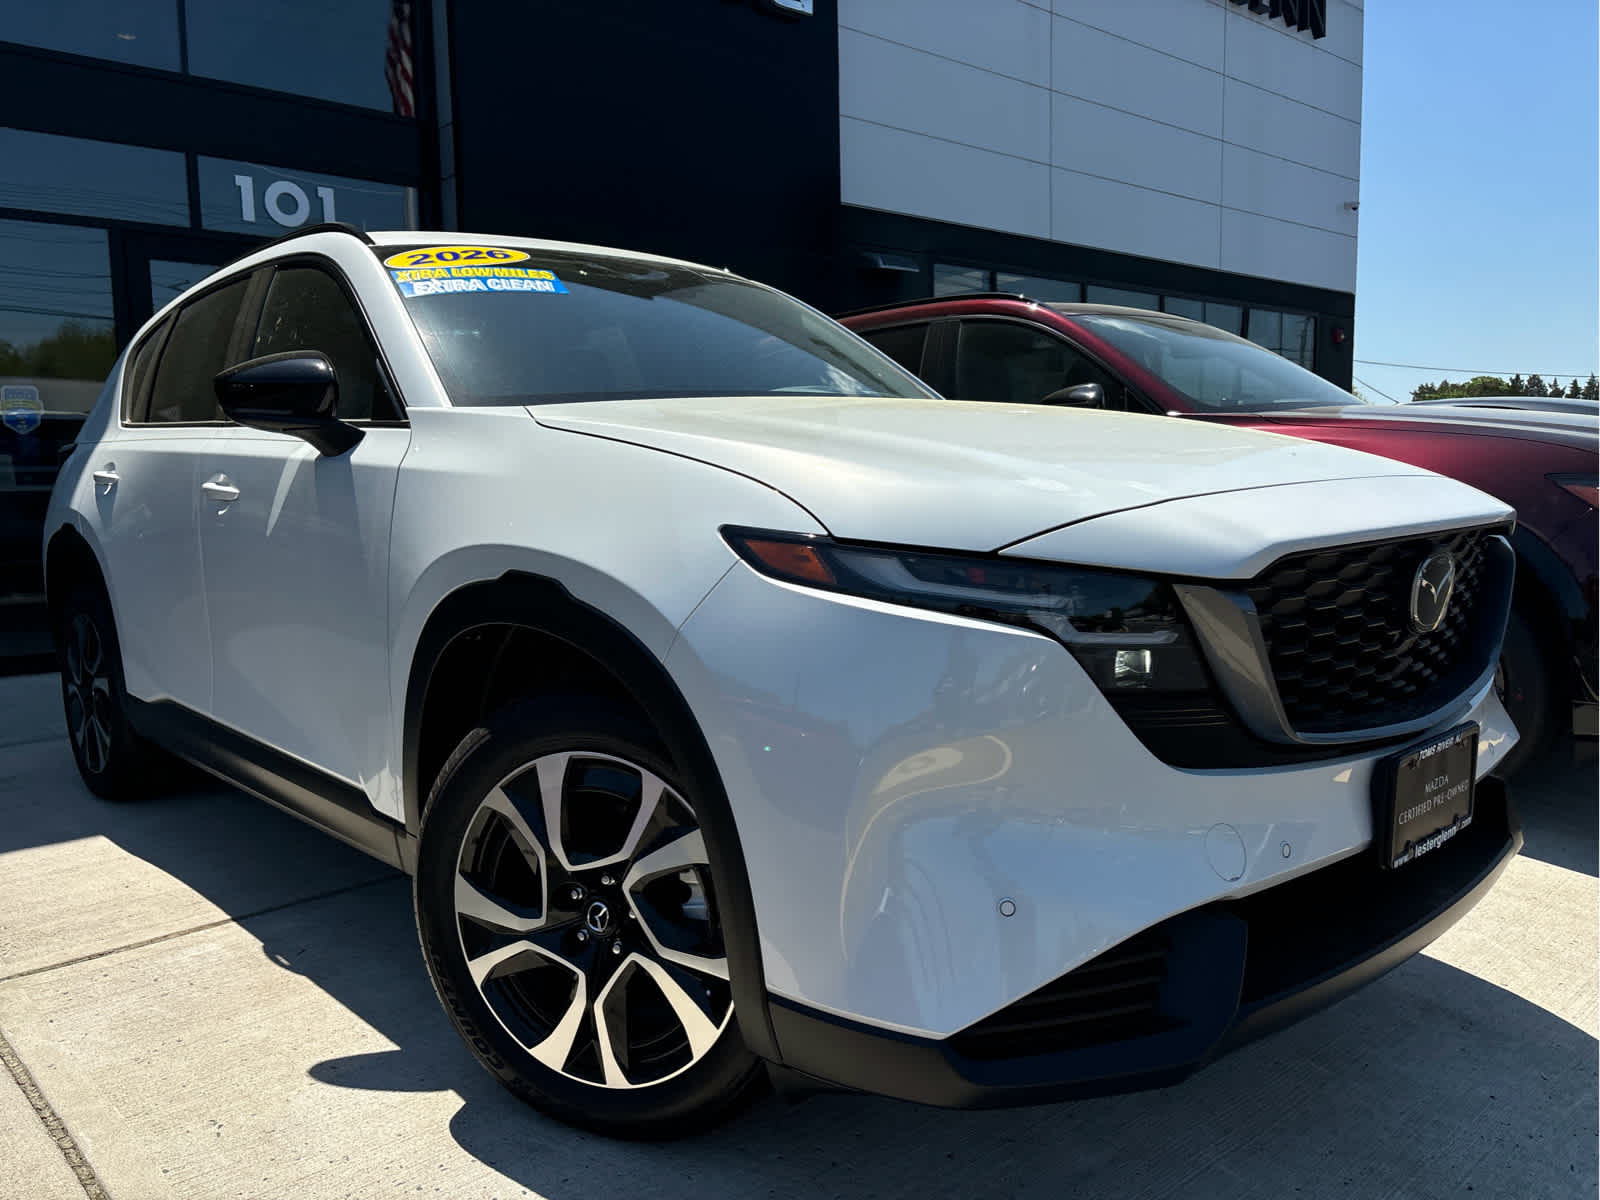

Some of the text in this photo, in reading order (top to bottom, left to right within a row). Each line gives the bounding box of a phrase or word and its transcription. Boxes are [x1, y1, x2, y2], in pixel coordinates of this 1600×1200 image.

[234, 174, 337, 228] 101
[408, 250, 510, 265] 2026
[396, 267, 555, 283] XTRA LOW MILES
[413, 278, 555, 295] EXTRA CLEAN
[1437, 737, 1454, 752] RIVER
[1425, 775, 1449, 793] MAZDA
[1398, 779, 1470, 825] CERTIFIED PRE-OWNED
